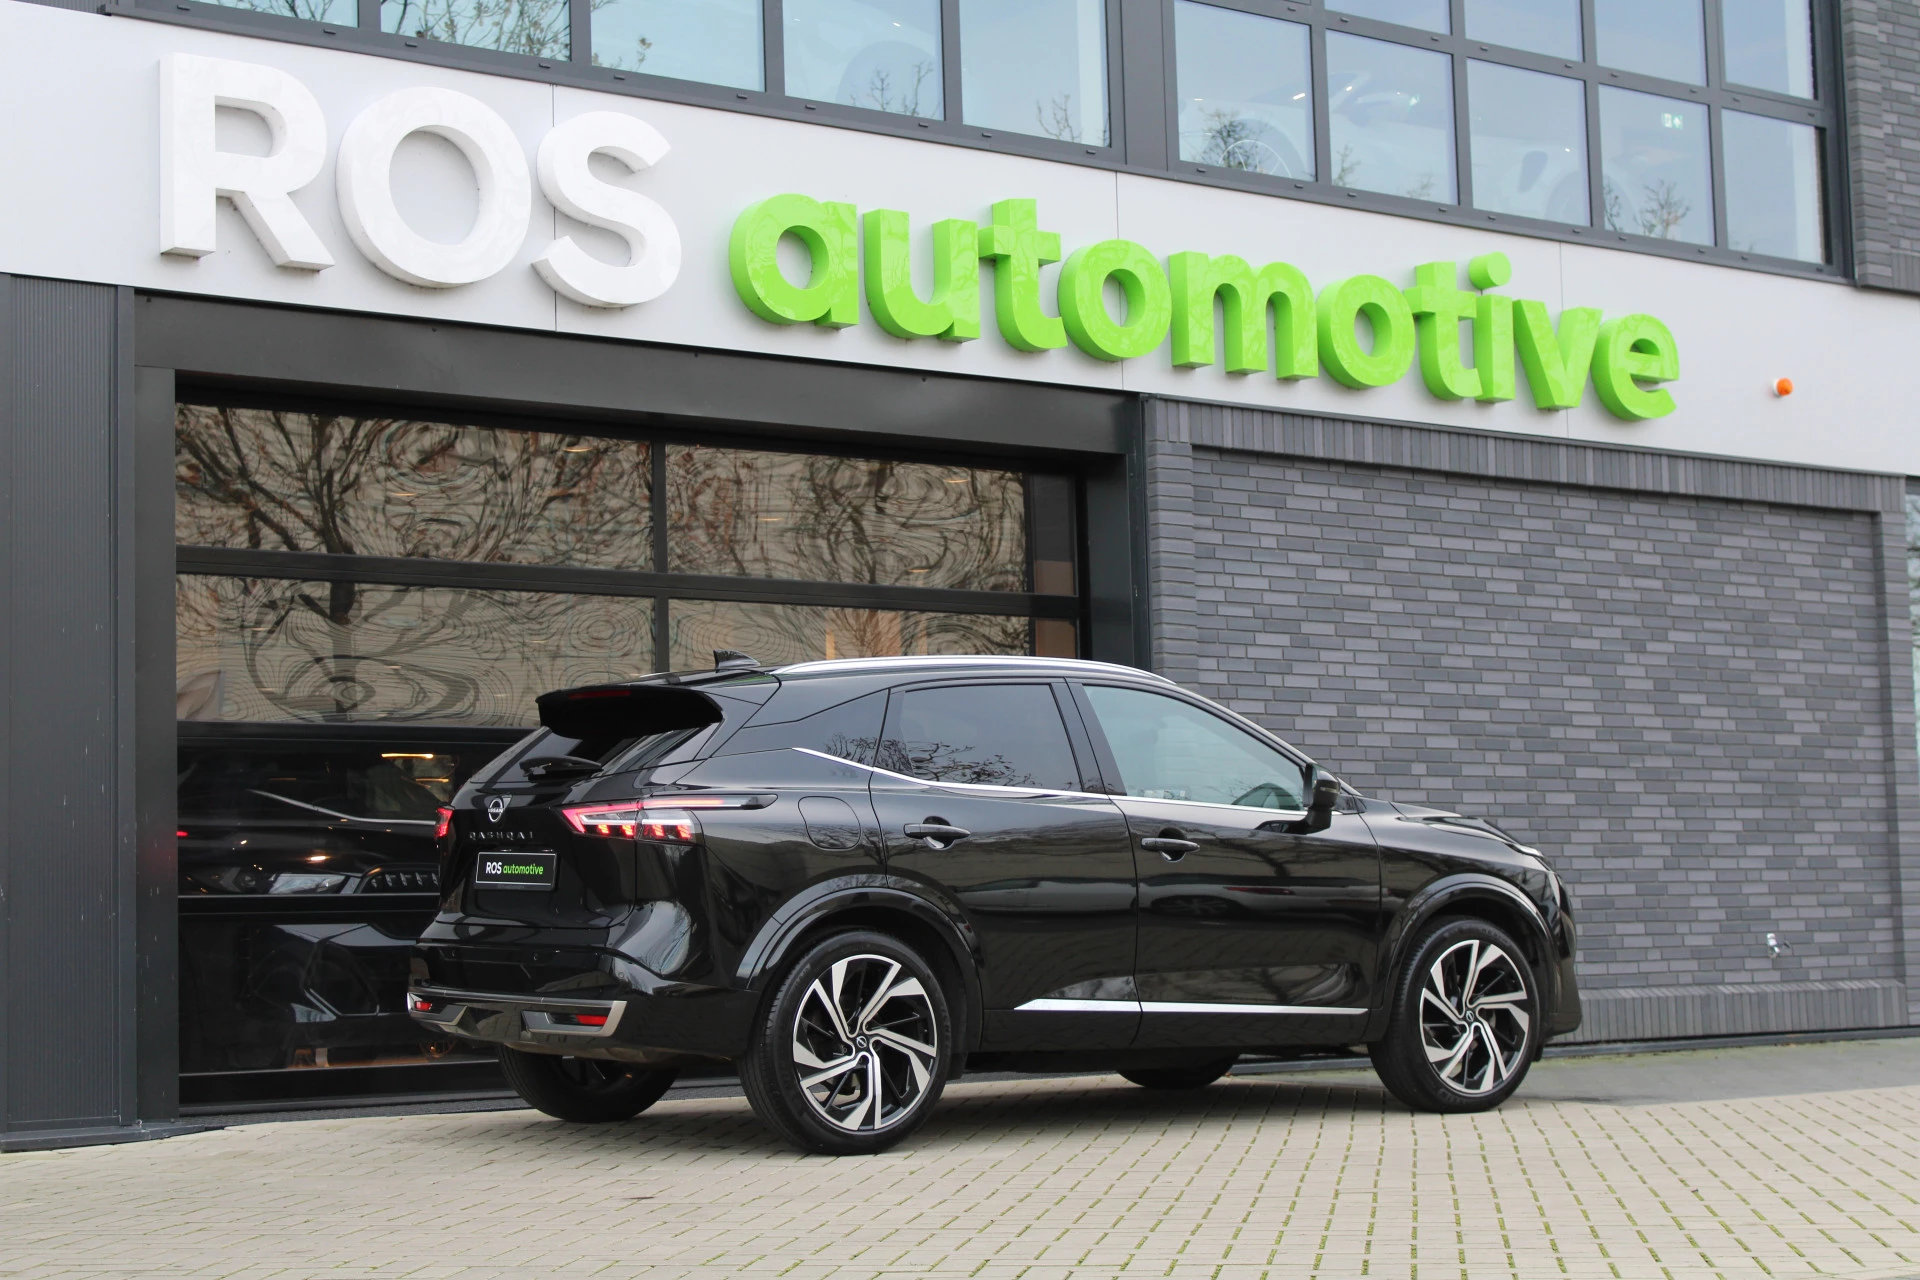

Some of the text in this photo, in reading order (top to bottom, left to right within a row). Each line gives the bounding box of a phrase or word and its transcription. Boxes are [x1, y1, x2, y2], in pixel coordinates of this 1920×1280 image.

[159, 52, 1680, 421] ROS automotive
[469, 831, 534, 840] QASHQAI
[485, 862, 544, 875] ROS automotive
